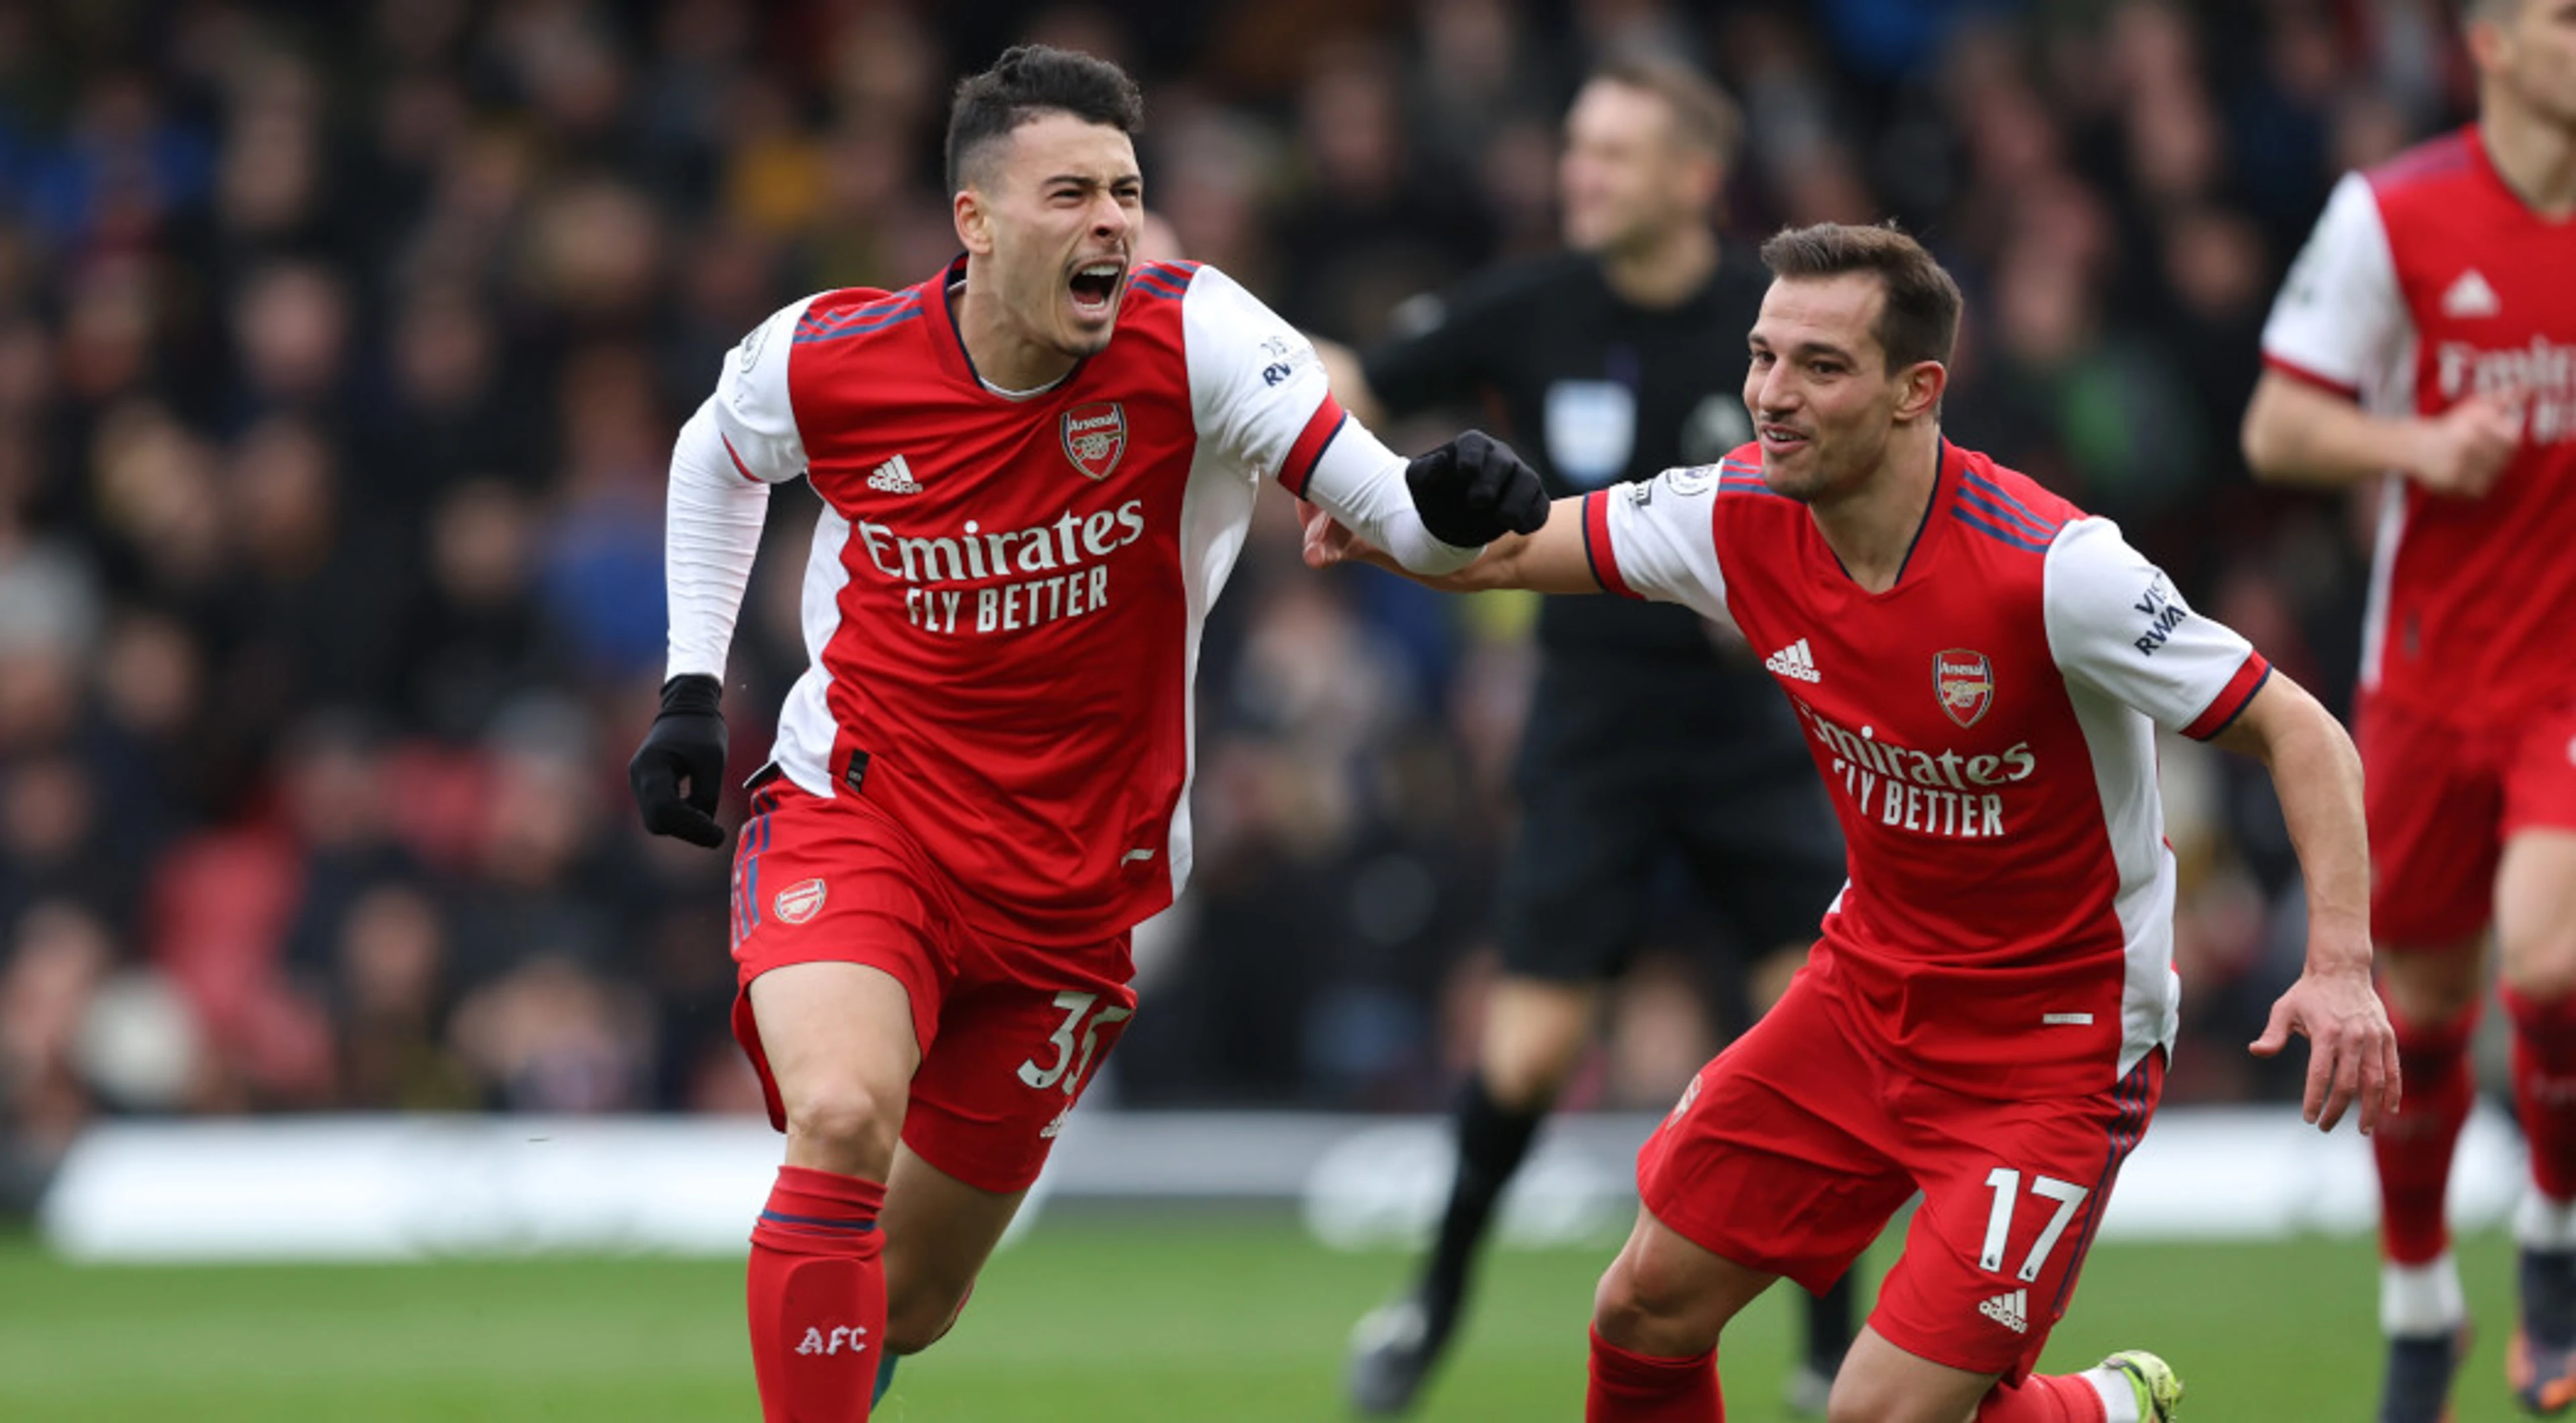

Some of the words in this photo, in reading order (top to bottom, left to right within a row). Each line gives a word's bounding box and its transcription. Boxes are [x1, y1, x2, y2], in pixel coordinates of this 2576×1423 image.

[1069, 412, 1118, 430] Arsenal
[867, 474, 923, 494] adidas
[859, 499, 1144, 582] Emirates
[906, 587, 962, 633] FLY
[977, 564, 1108, 633] BETTER
[1766, 656, 1821, 683] adidas
[1941, 661, 1984, 676] Arsenal
[1882, 779, 2004, 837] BETTER
[1016, 990, 1132, 1096] 35
[1979, 1167, 2088, 1283] 17
[1979, 1300, 2028, 1334] adidas
[795, 1325, 867, 1355] AFC
